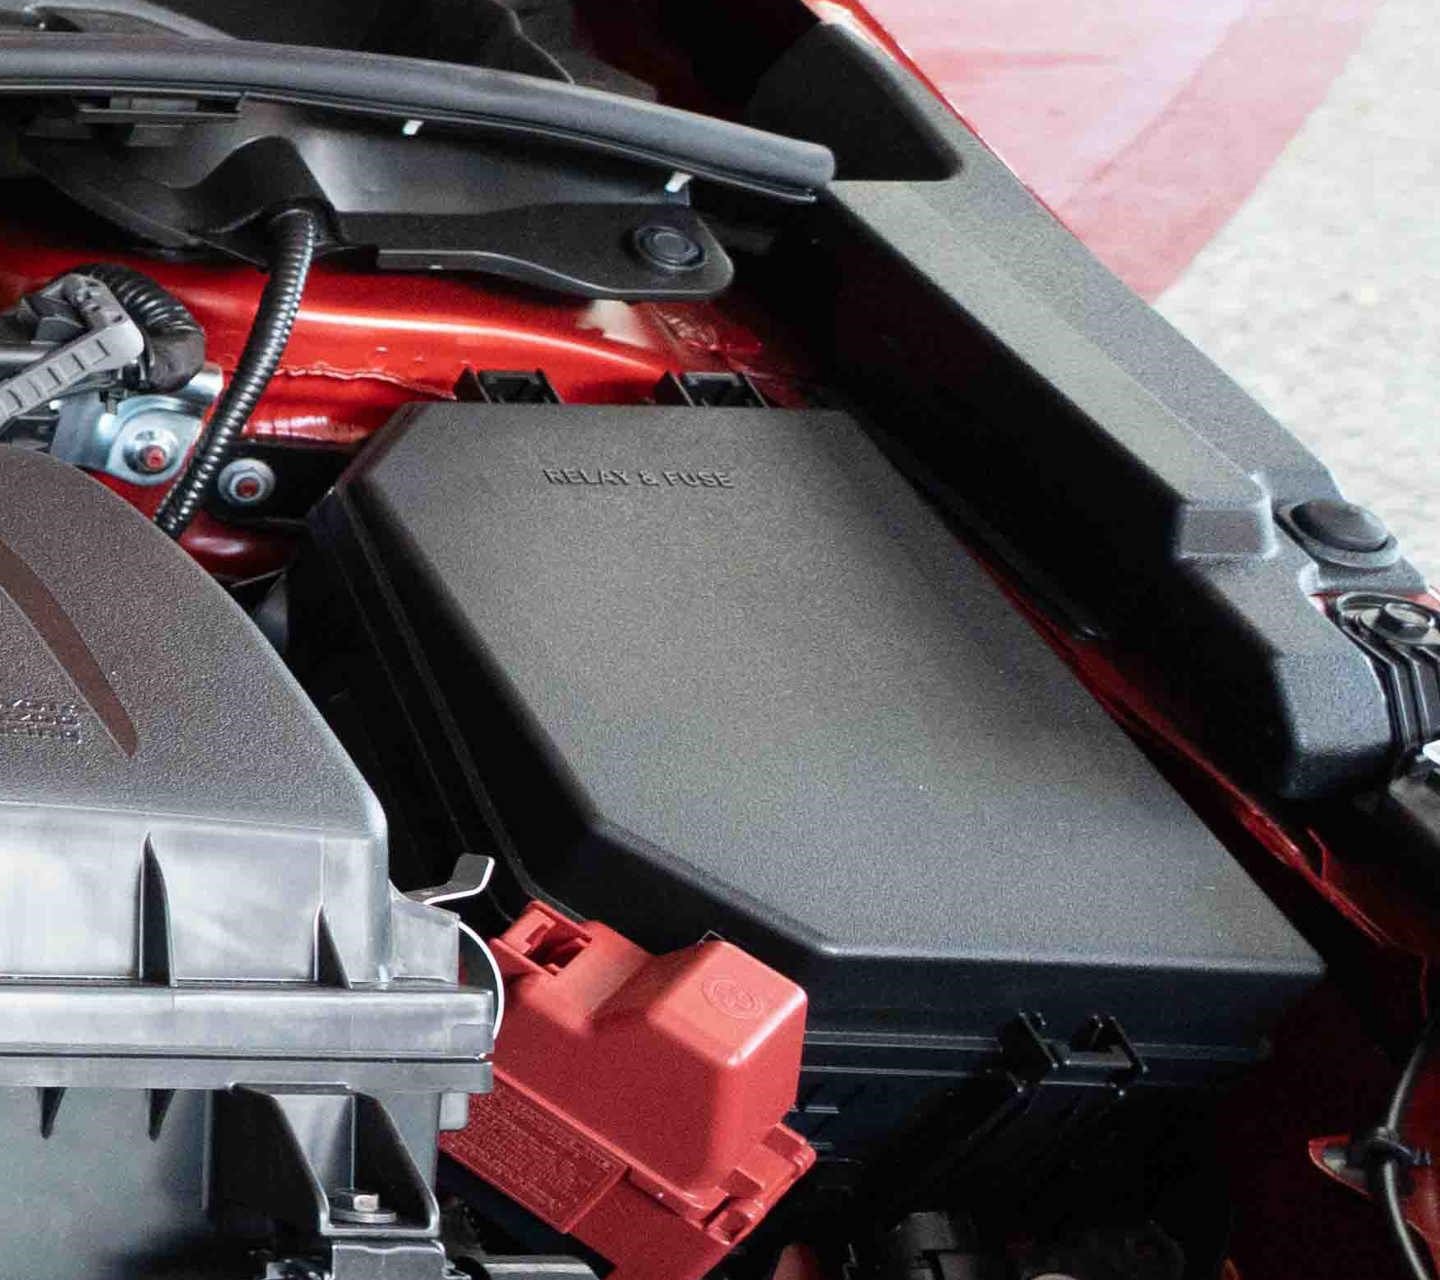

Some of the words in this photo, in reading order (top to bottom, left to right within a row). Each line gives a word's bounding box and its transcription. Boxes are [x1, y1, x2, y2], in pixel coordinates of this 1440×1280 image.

[543, 467, 629, 486] RELAY
[638, 469, 660, 487] &
[663, 470, 735, 489] FUSE
